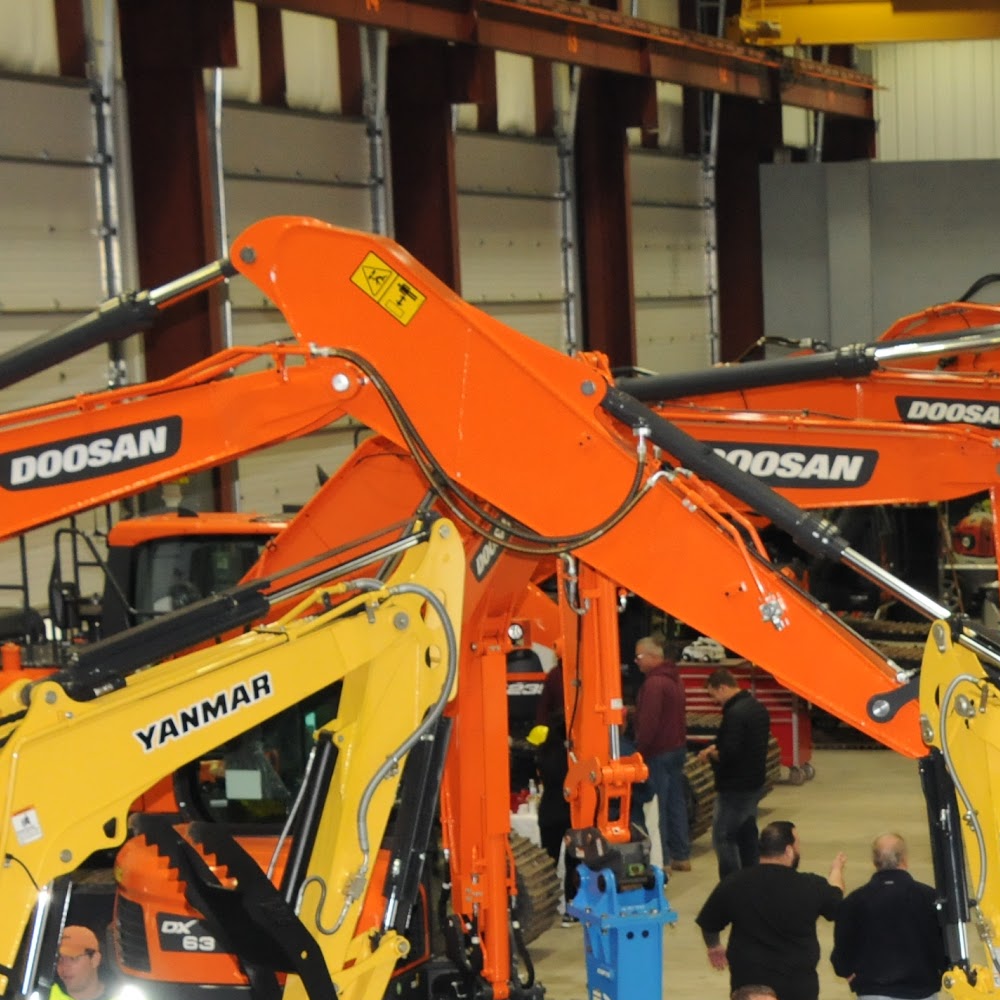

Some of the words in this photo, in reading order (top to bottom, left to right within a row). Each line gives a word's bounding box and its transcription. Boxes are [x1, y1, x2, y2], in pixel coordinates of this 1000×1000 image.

[10, 425, 168, 486] DOOSAN
[713, 448, 864, 482] OOSAN
[135, 673, 271, 751] YANMAR
[161, 919, 198, 935] DX
[182, 935, 216, 951] 63
